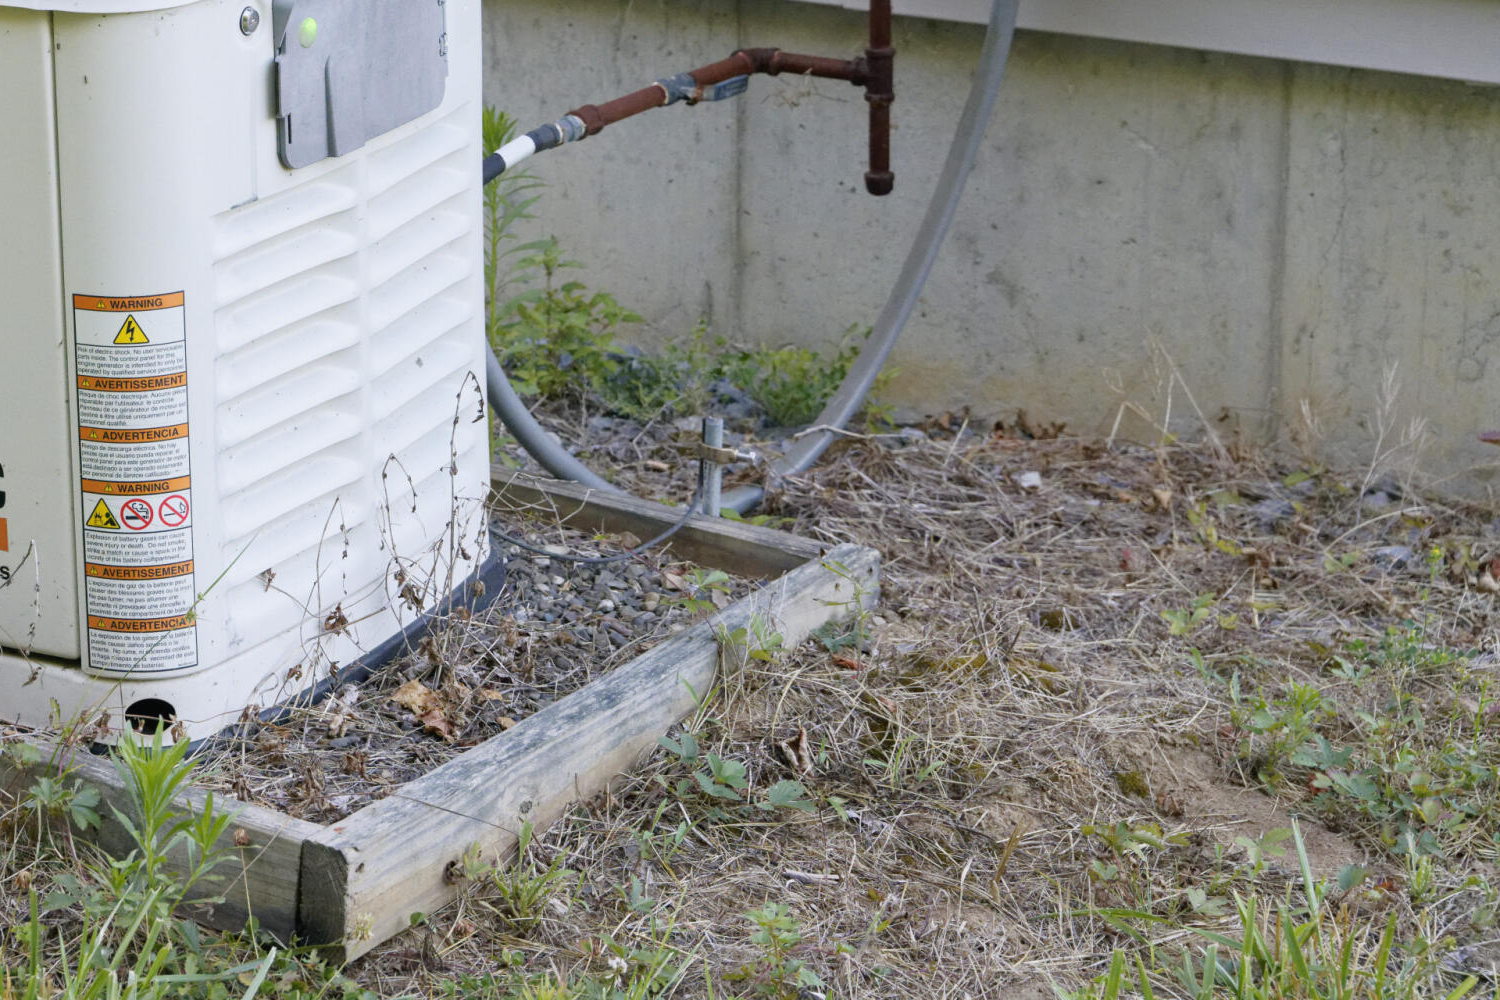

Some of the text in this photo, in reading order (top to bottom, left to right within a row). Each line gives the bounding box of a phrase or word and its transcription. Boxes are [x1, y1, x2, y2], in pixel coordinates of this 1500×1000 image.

[109, 297, 163, 309] WARNING
[94, 375, 184, 389] AVERTISSEMENT
[102, 429, 179, 441] ADVERTENCIA
[117, 481, 170, 493] WARNING
[102, 563, 191, 578] AVERTISSEMENT
[110, 618, 187, 630] ADVERTENCIA
